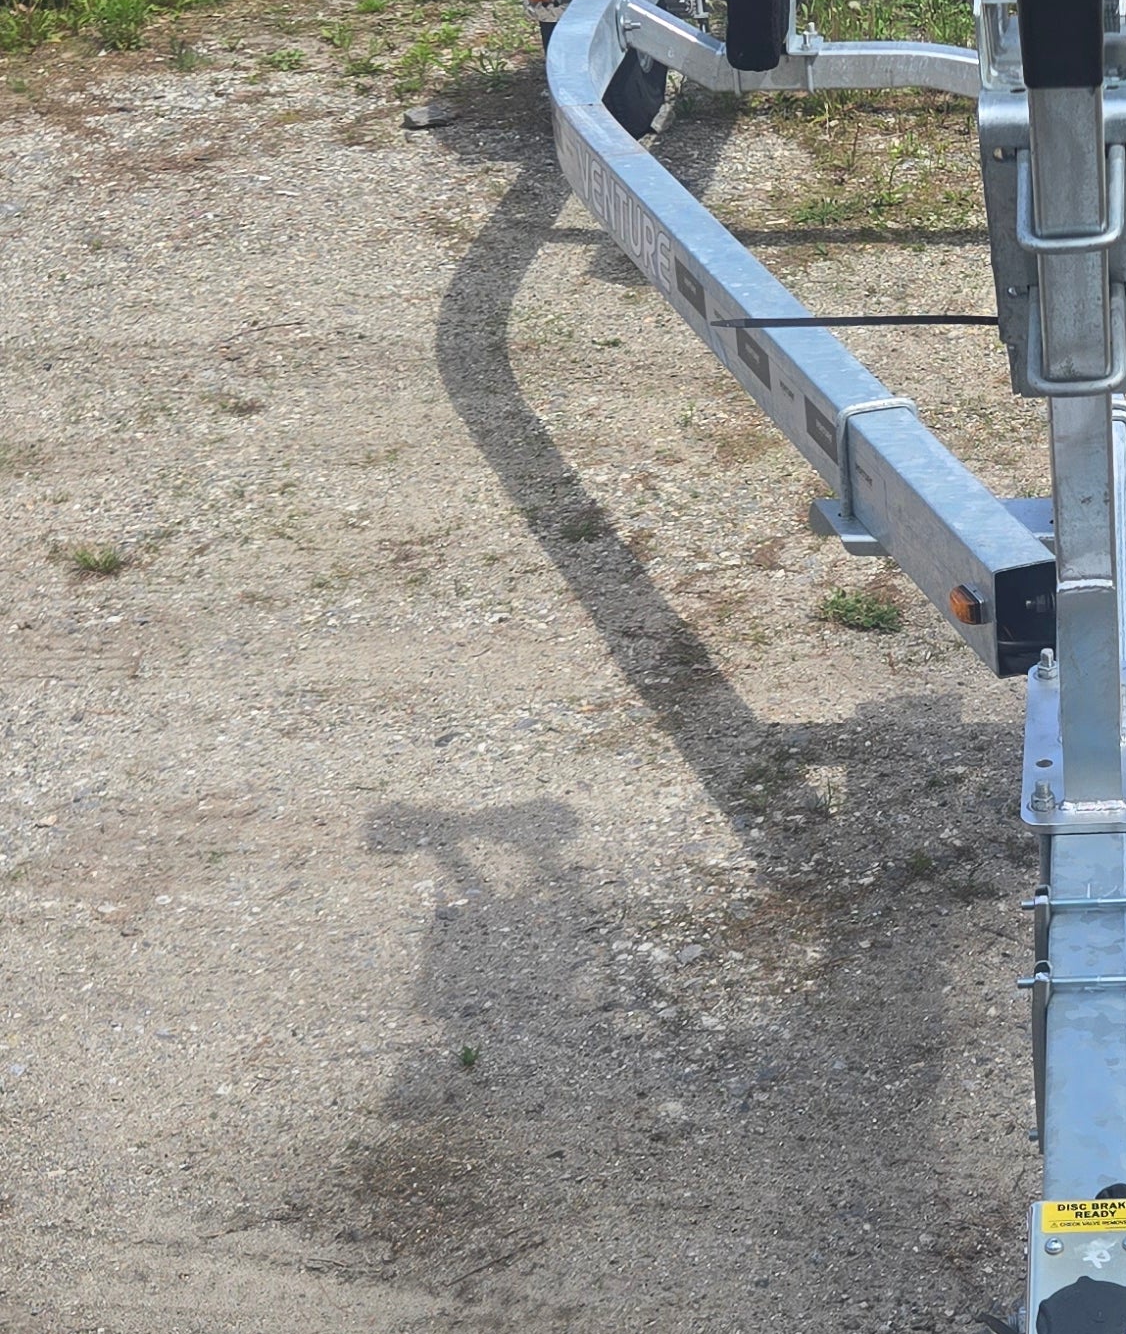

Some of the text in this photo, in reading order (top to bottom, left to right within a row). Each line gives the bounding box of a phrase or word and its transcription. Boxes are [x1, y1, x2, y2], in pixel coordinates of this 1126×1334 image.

[577, 140, 672, 295] VENTURE
[1057, 1203, 1087, 1212] DISC
[1075, 1209, 1117, 1219] READY
